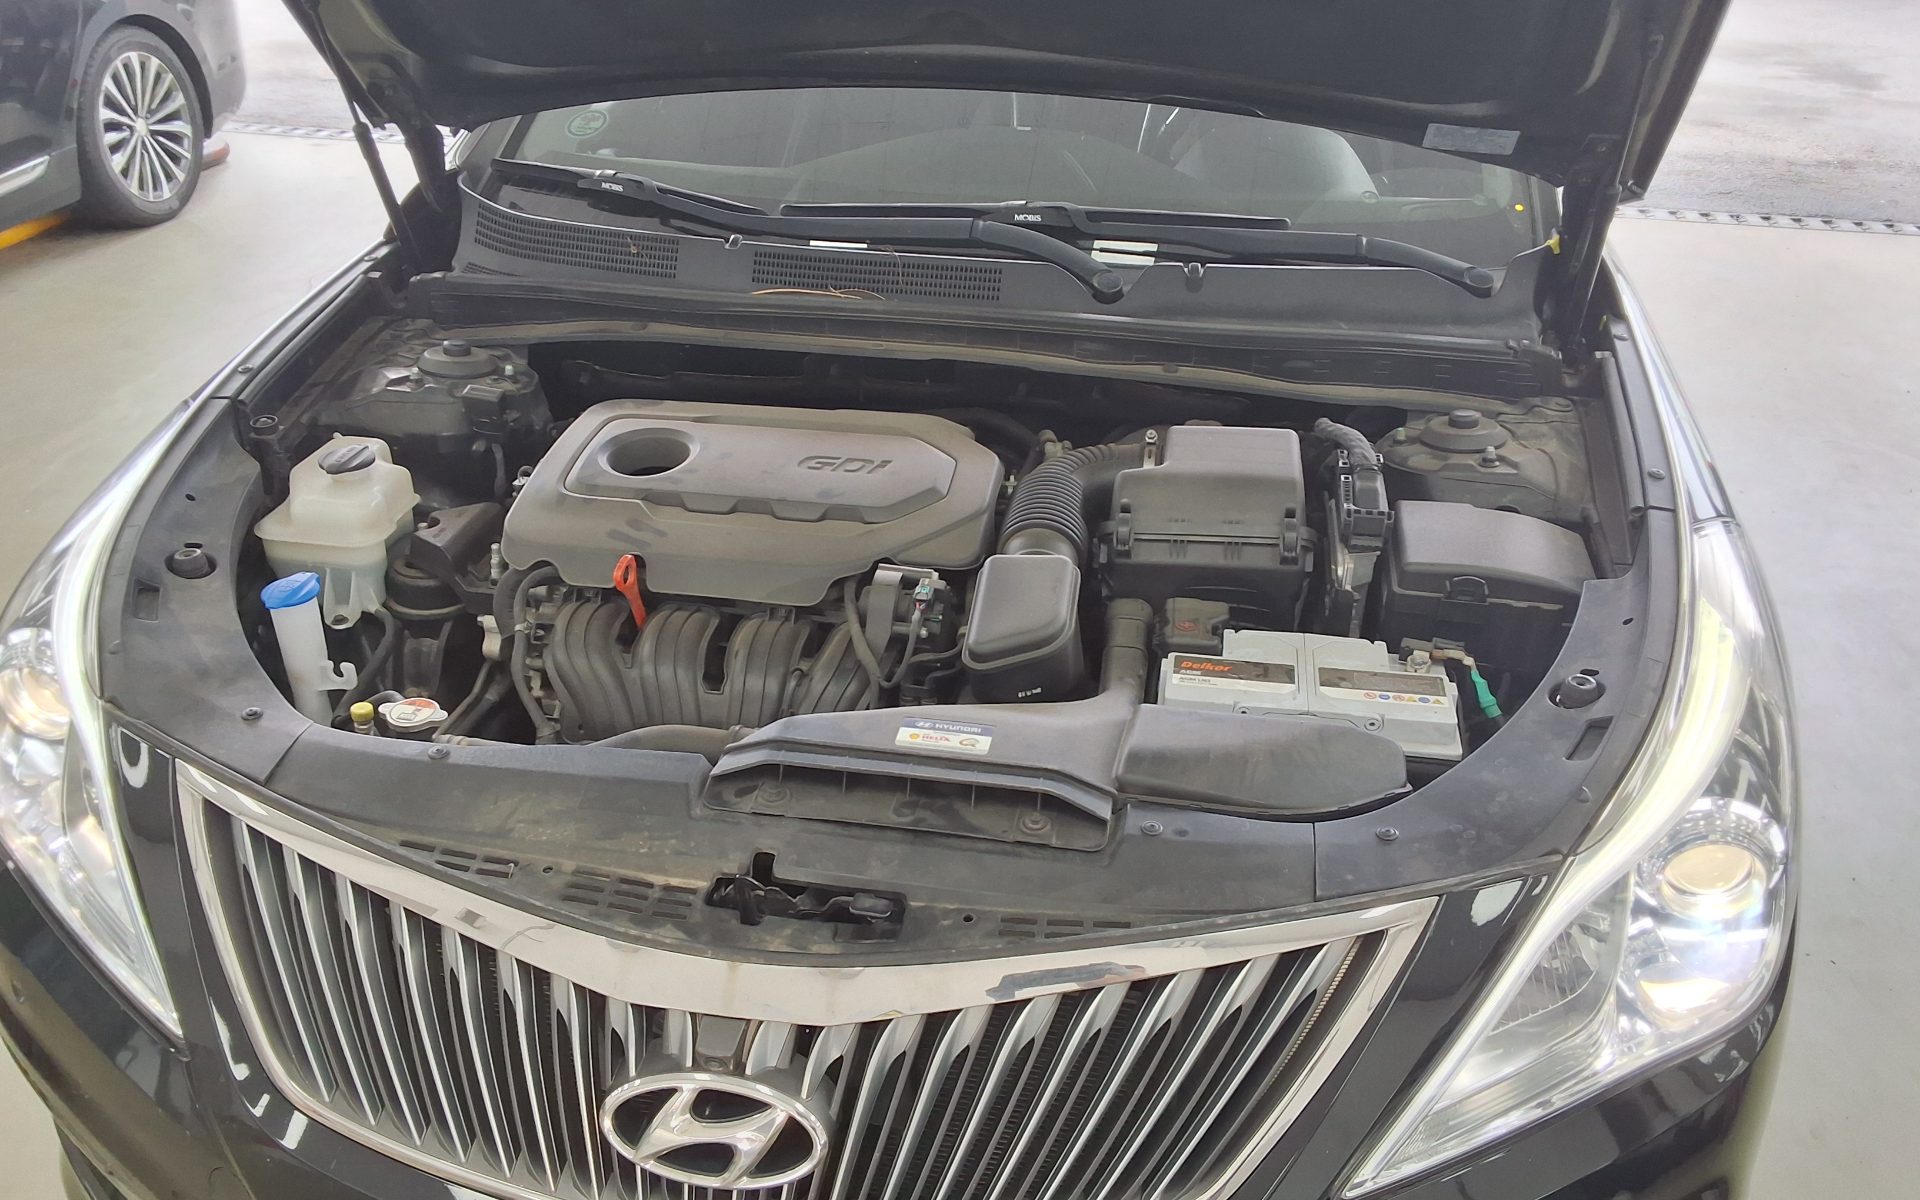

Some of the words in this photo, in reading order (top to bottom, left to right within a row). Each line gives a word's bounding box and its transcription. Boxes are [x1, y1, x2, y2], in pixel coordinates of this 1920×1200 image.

[1014, 213, 1042, 221] MOBIS
[1180, 660, 1233, 672] Delkor
[935, 722, 982, 733] HYUNDAI
